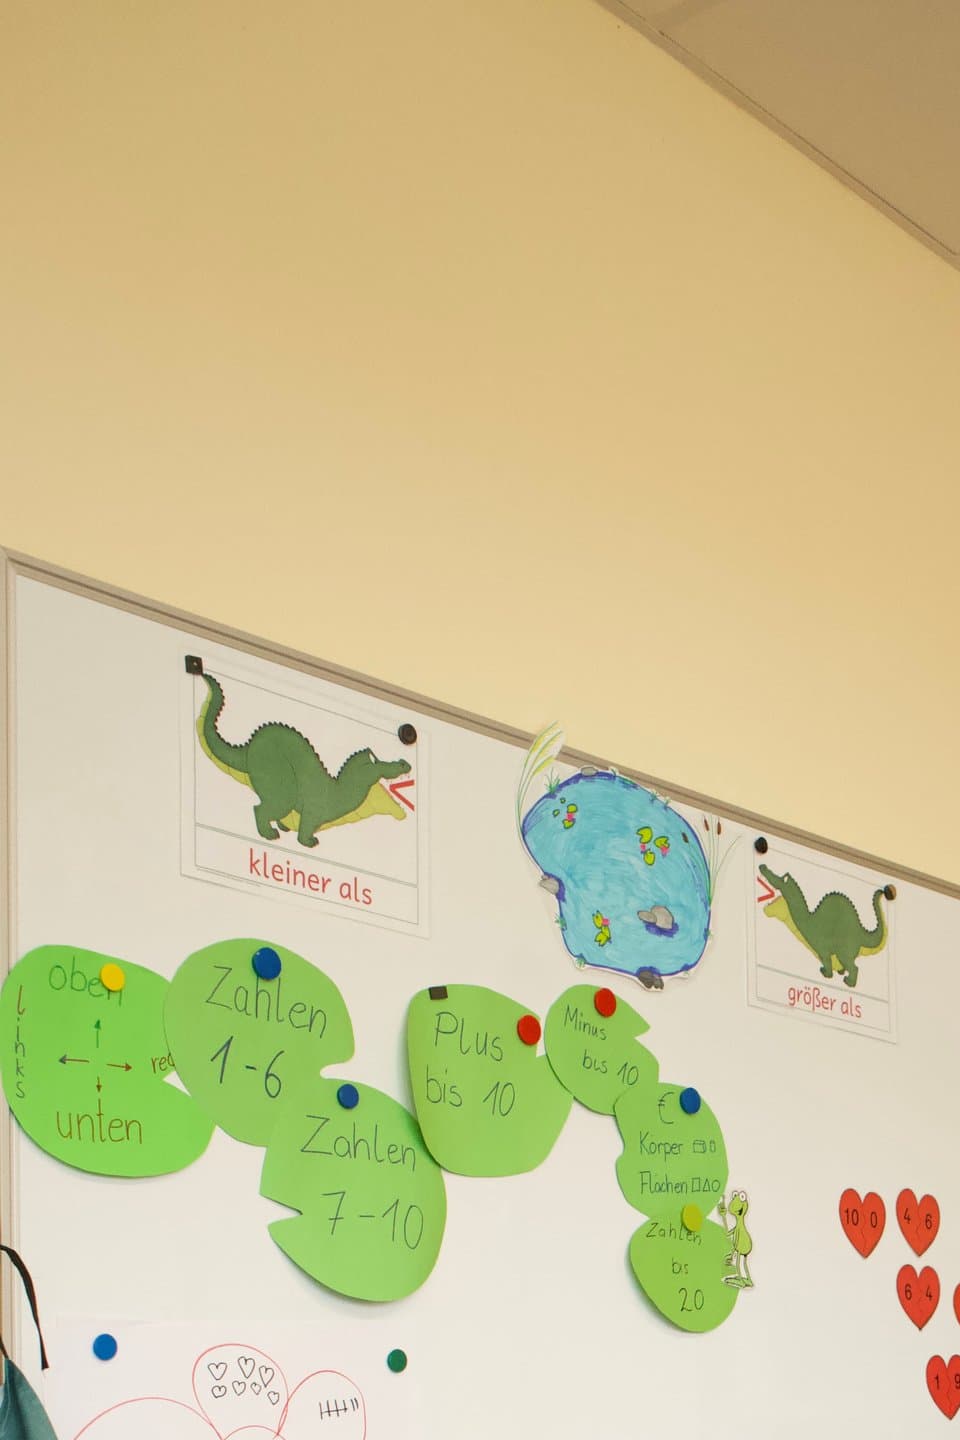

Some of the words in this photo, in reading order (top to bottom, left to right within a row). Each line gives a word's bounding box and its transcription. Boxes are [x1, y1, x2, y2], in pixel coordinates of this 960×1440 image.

[249, 848, 333, 894] kleiner
[339, 877, 374, 906] als
[205, 965, 327, 1039] Zahlen
[787, 985, 837, 1013] größer
[841, 999, 862, 1018] als
[434, 1011, 504, 1062] Plus
[563, 1004, 607, 1041] Minus
[582, 1049, 608, 1074] bis
[617, 1062, 639, 1086] 10
[426, 1064, 463, 1108] bis
[482, 1082, 516, 1118] 10
[56, 1097, 143, 1145] unten
[300, 1114, 416, 1172] Zahlen
[646, 1222, 702, 1246] Zahlen
[844, 1208, 860, 1226] 10
[870, 1211, 878, 1229] 0
[903, 1208, 912, 1225] 4
[924, 1213, 933, 1230] 6
[671, 1257, 689, 1275] bis
[678, 1287, 705, 1312] 20
[904, 1284, 912, 1300] 6
[925, 1285, 934, 1300] 4
[934, 1375, 941, 1390] 1
